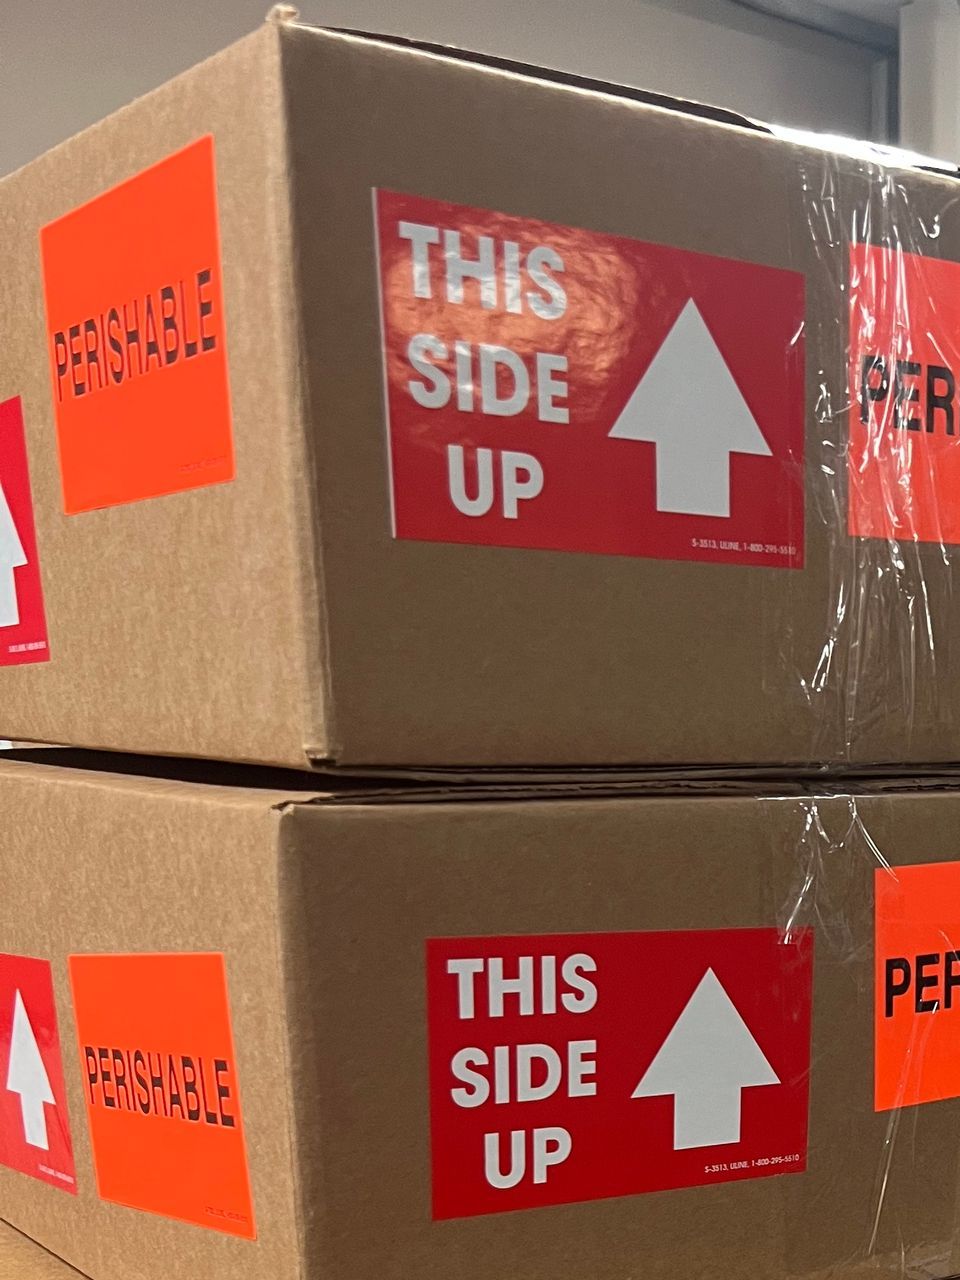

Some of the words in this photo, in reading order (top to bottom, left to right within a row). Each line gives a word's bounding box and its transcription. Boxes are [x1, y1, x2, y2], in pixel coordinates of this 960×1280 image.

[399, 221, 569, 321] THIS
[54, 269, 216, 402] PERISHABLE
[408, 332, 570, 424] SIDE
[447, 444, 544, 519] UP
[447, 953, 598, 1019] THIS
[85, 1046, 235, 1127] PERISHABLE
[451, 1040, 598, 1108] SIDE
[484, 1126, 572, 1189] UP
